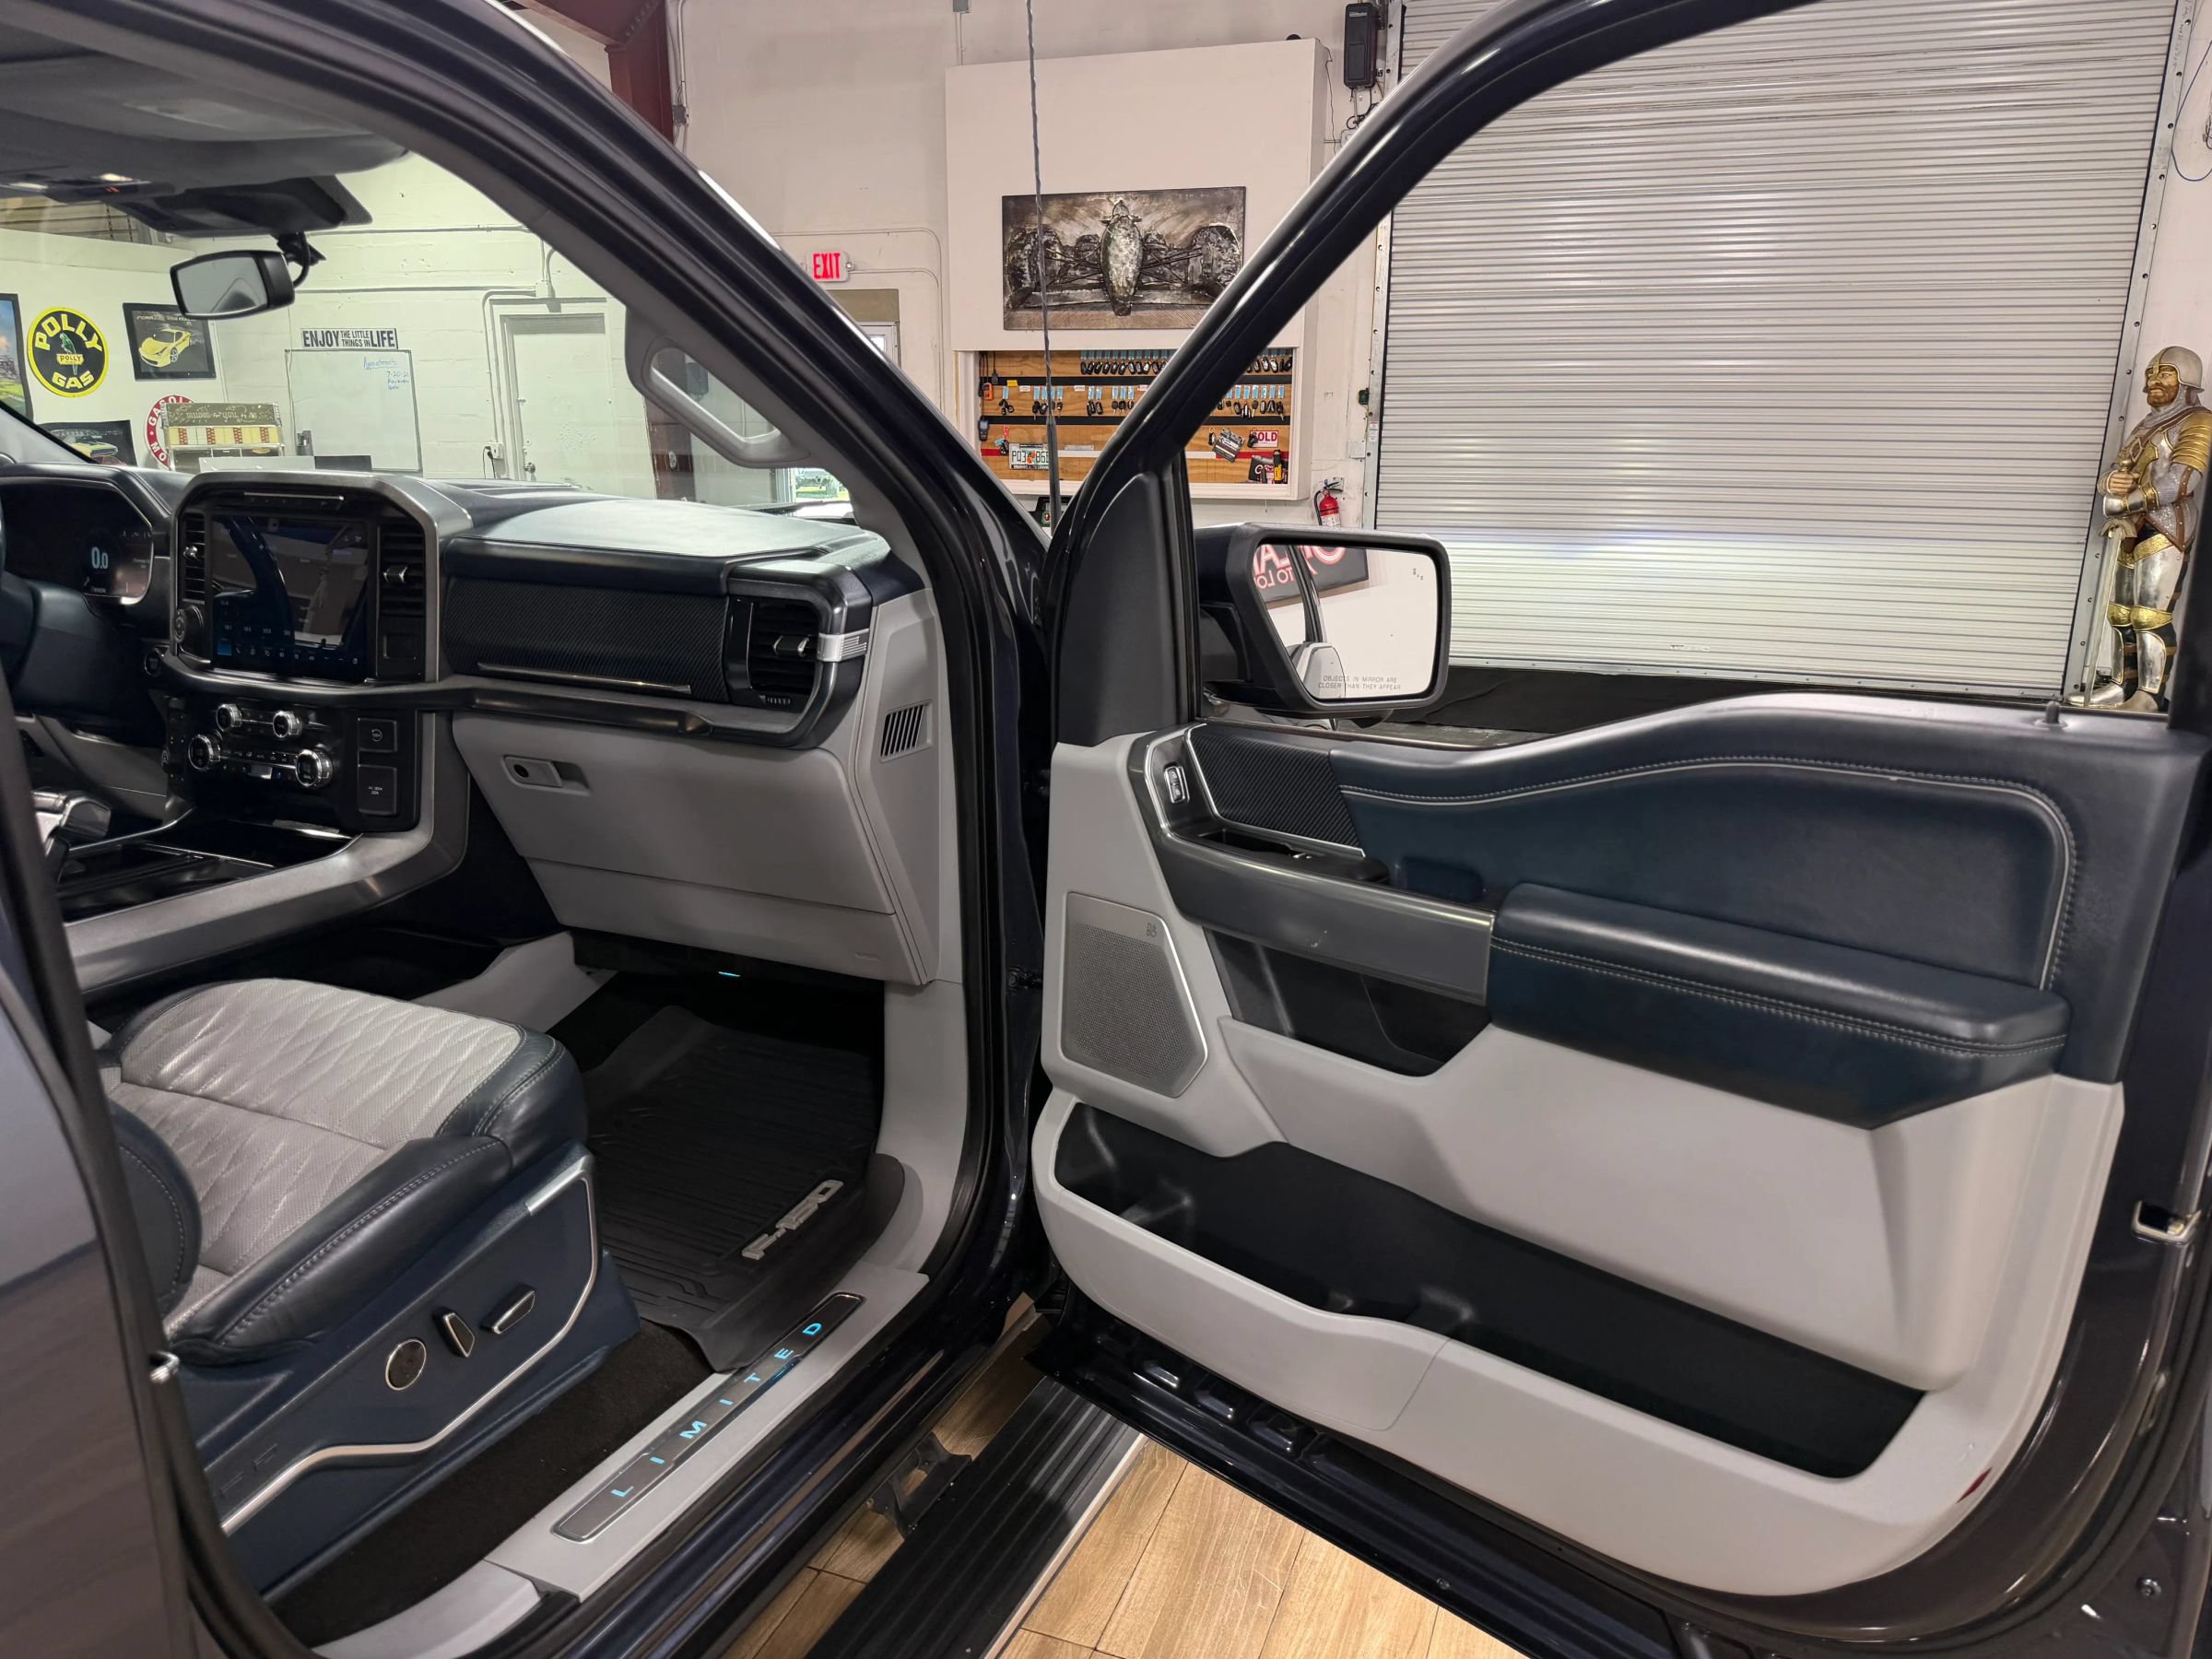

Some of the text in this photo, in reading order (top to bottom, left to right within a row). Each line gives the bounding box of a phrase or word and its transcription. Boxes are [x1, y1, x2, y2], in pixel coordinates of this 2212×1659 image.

[813, 253, 841, 280] EXIT
[35, 314, 102, 351] POLLY
[302, 331, 339, 347] ENJOY
[370, 331, 395, 347] LIFE
[52, 371, 94, 389] GAS
[91, 547, 109, 569] 0.0
[611, 1323, 823, 1498] LIMITED
